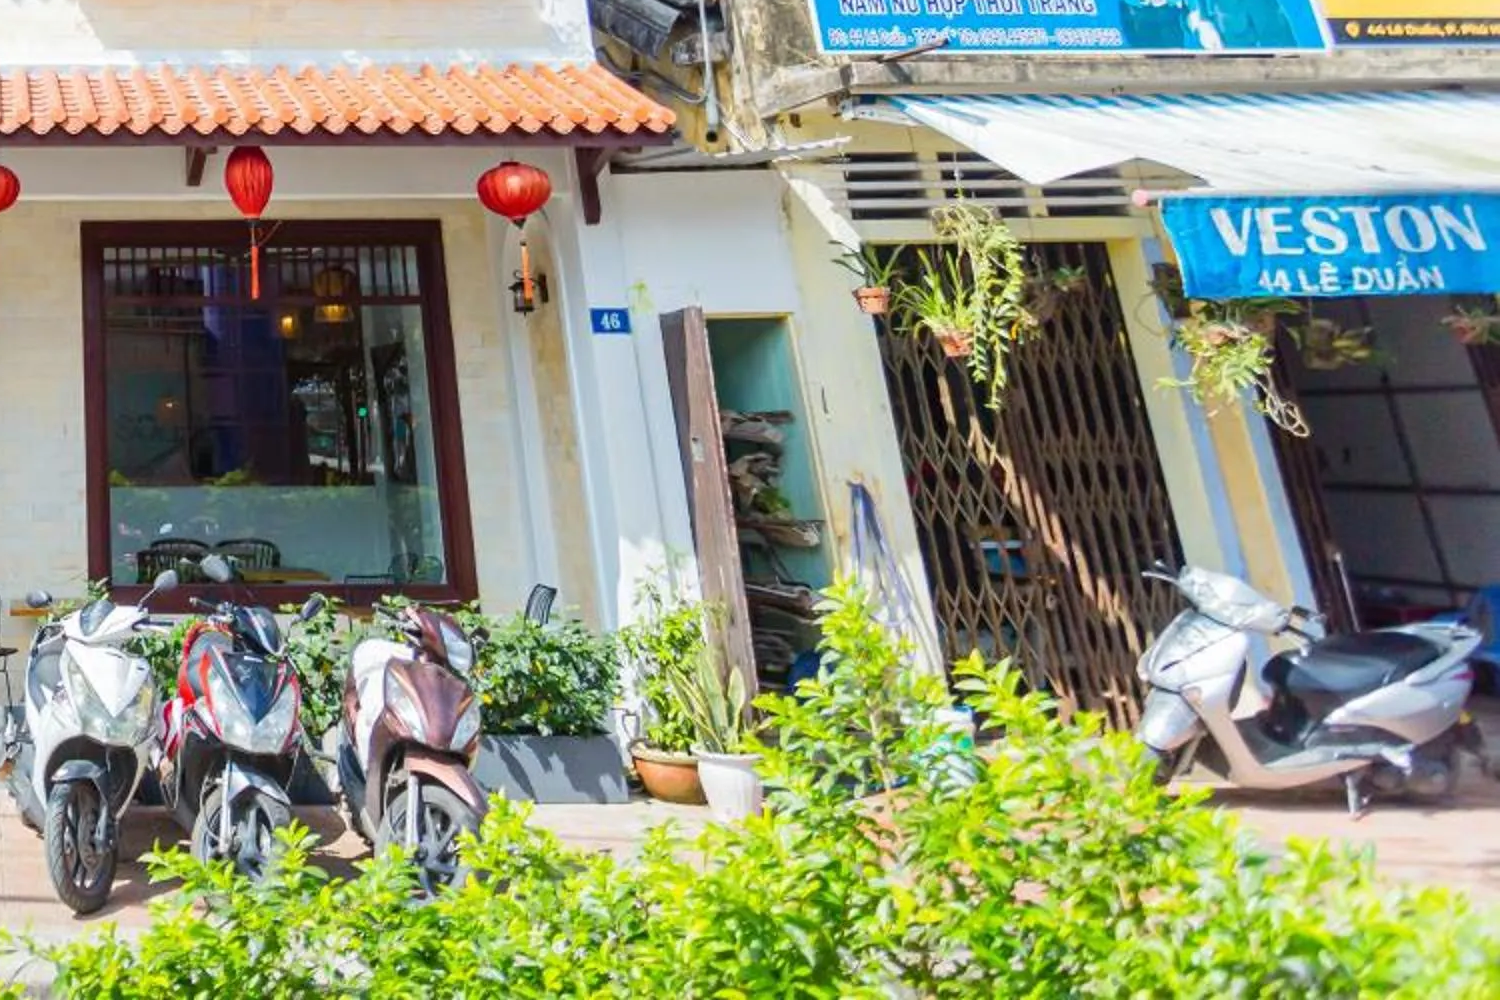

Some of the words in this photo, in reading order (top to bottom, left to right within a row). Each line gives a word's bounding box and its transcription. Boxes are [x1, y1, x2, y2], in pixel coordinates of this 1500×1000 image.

[1209, 204, 1488, 257] VESTON
[1259, 266, 1292, 292] 44
[1300, 261, 1342, 292] LÊ
[600, 311, 621, 331] 46
